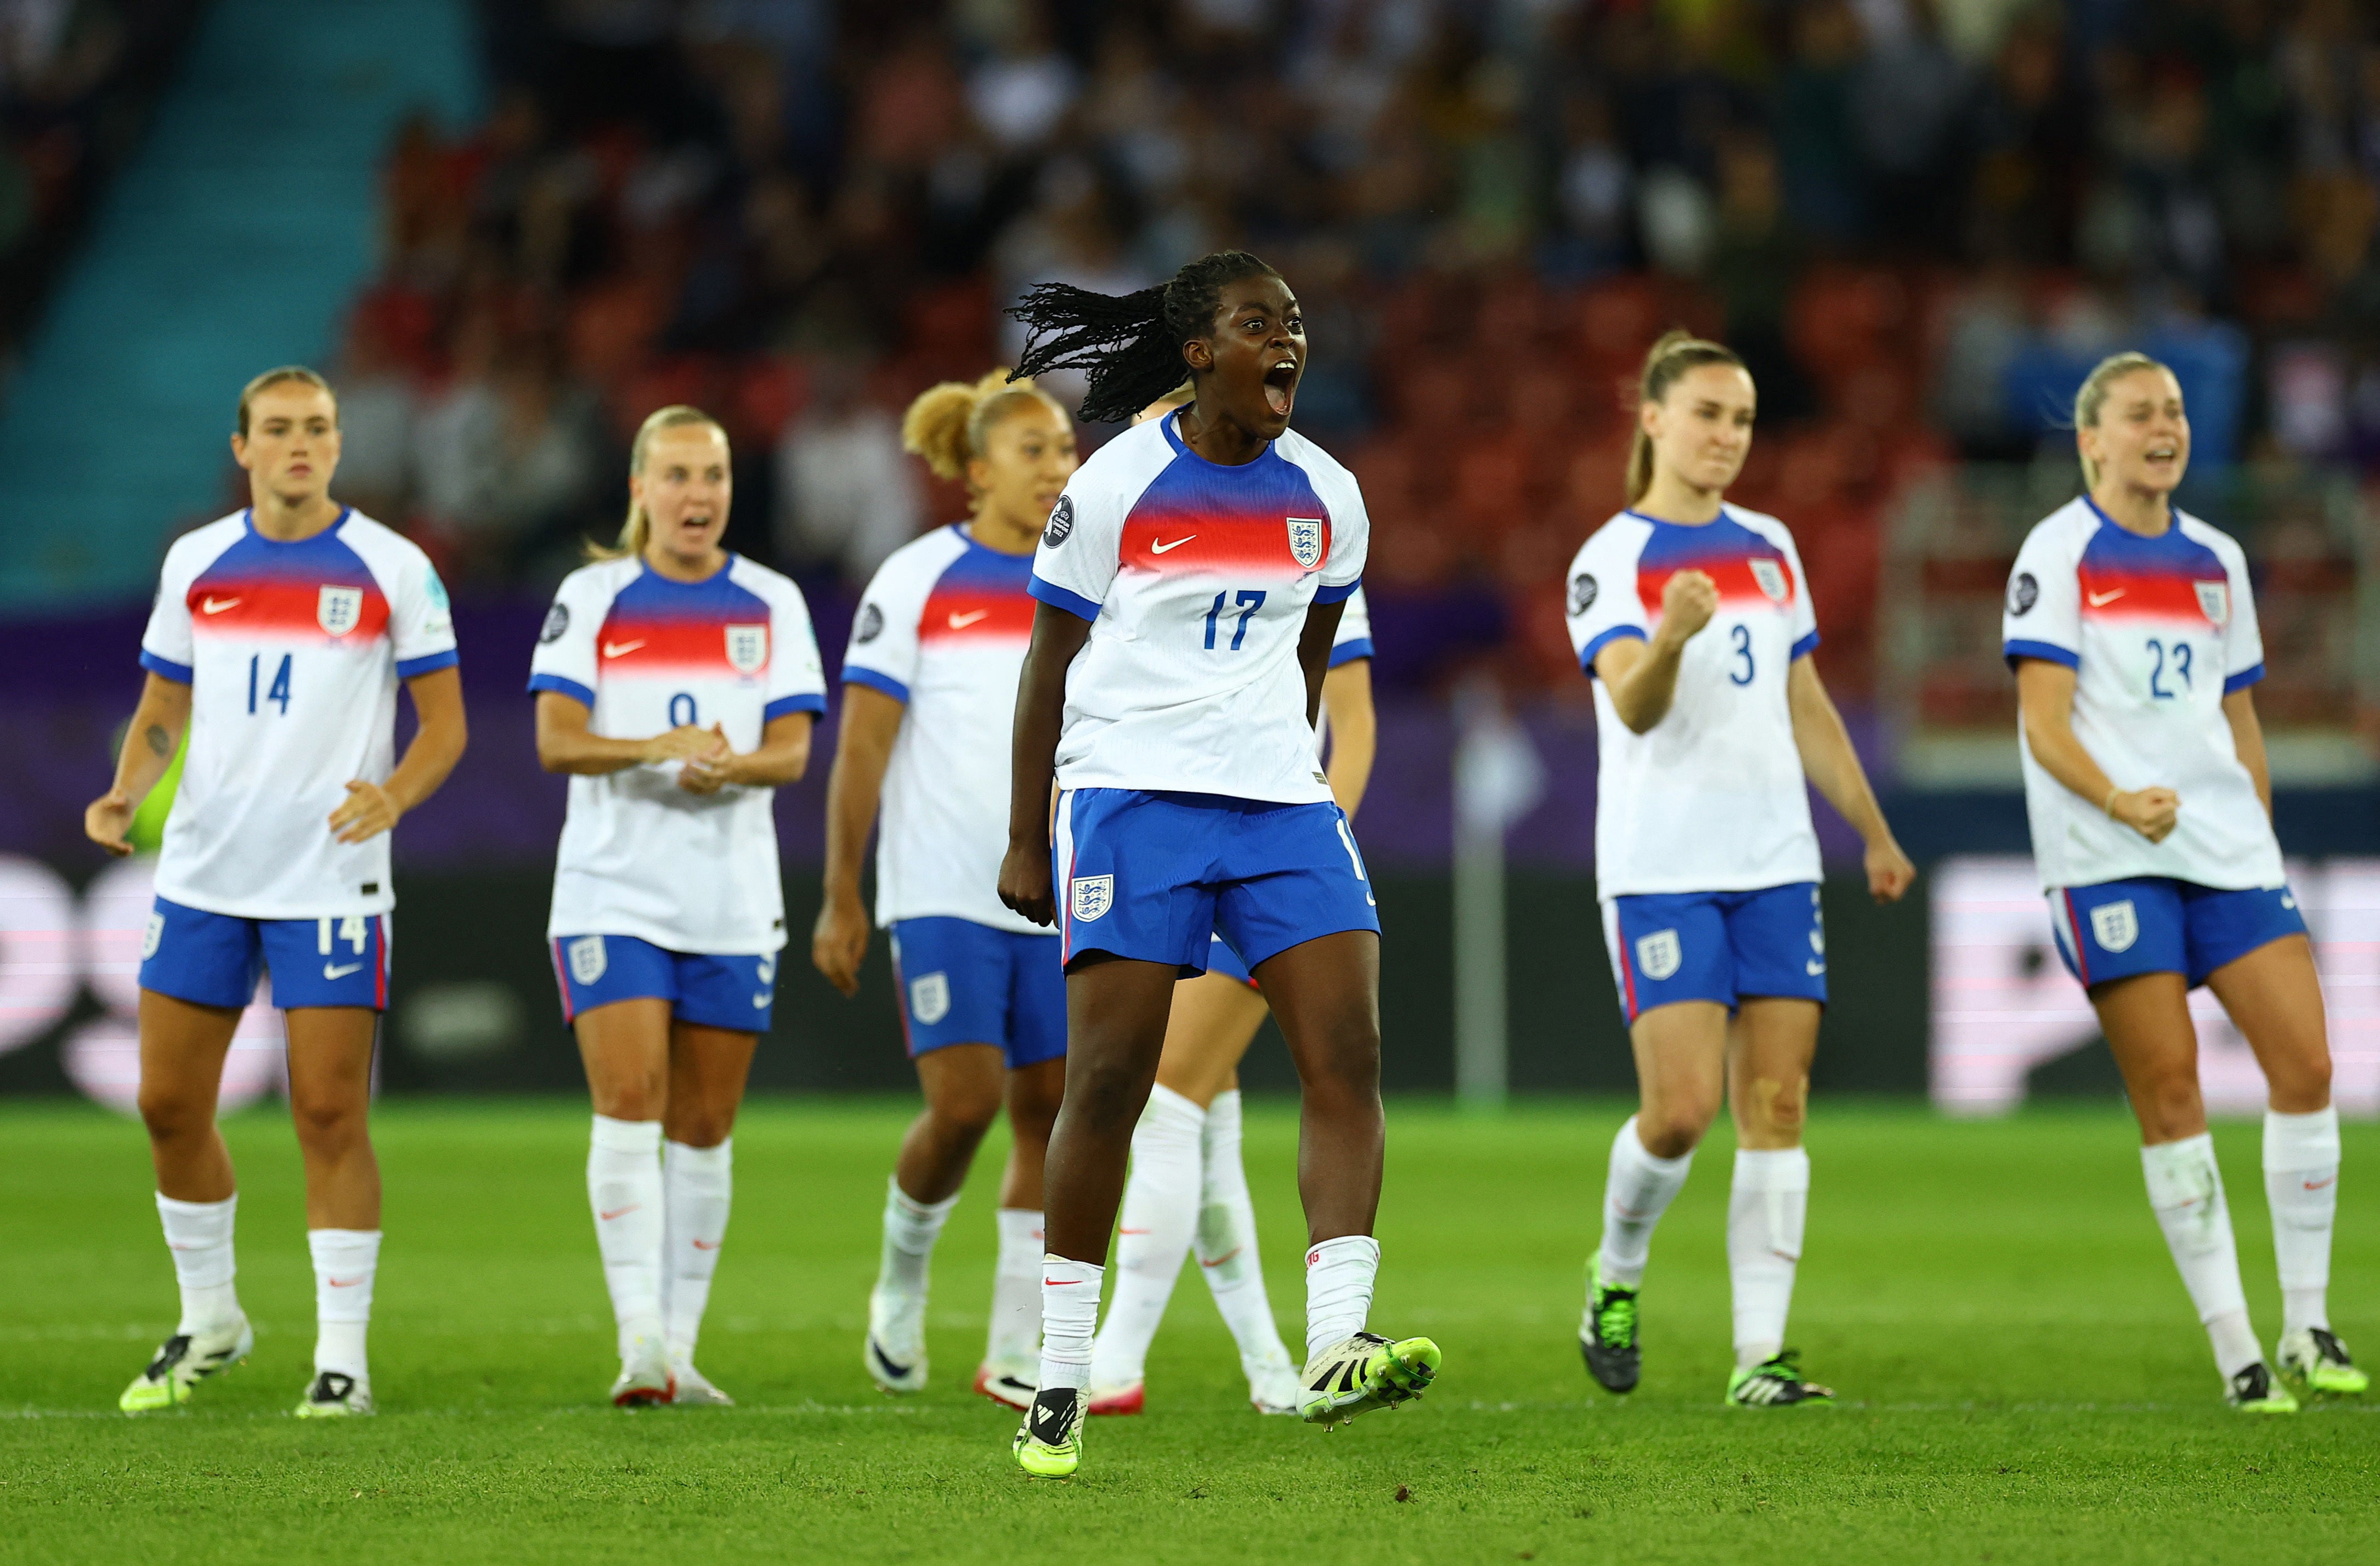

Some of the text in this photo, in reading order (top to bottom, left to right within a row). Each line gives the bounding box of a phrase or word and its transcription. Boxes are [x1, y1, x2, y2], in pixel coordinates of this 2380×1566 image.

[1053, 528, 1064, 538] 2022
[1204, 590, 1267, 651] 17
[248, 653, 292, 715] 14
[1731, 624, 1754, 685] 3
[2146, 639, 2192, 697] 23
[318, 916, 368, 956] 14
